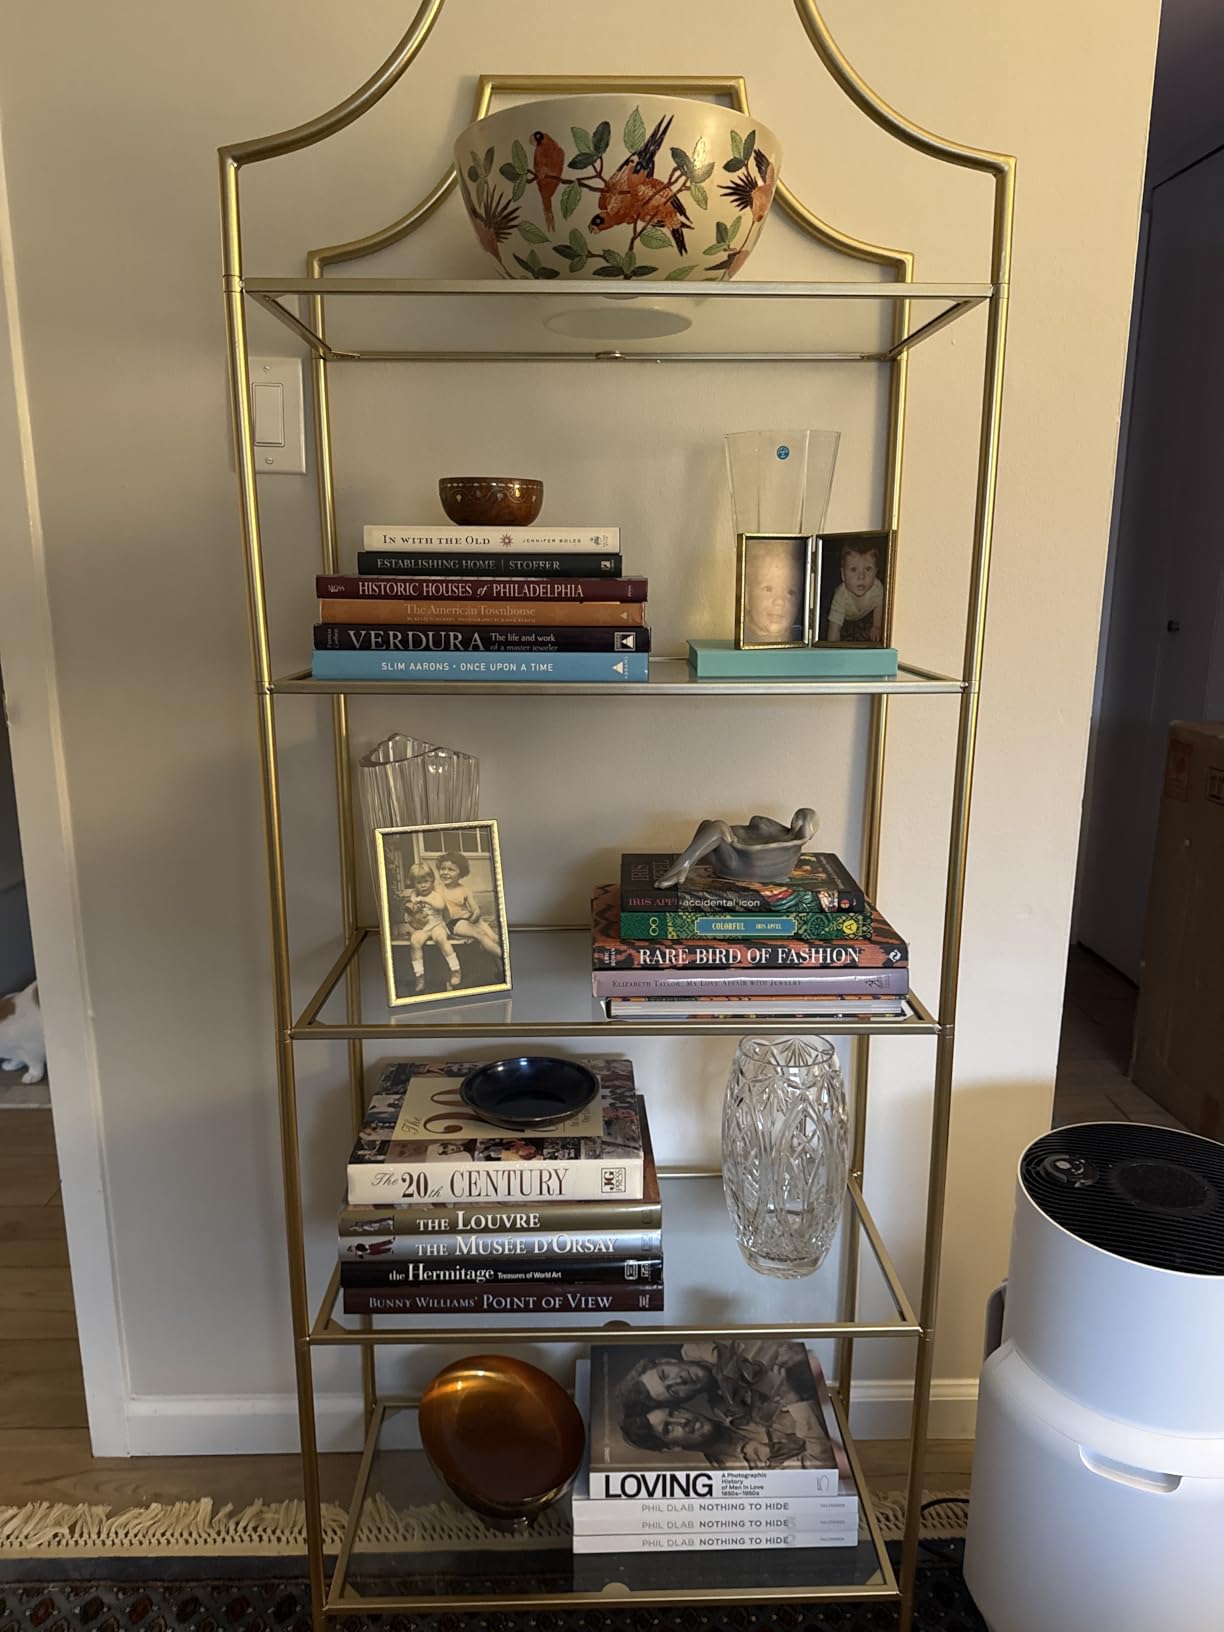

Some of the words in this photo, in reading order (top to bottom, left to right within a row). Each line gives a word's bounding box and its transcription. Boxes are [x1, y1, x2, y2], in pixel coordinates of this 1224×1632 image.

[383, 534, 396, 544] IN
[401, 536, 433, 545] WITH
[437, 536, 462, 545] THE
[465, 535, 490, 545] OLD
[377, 558, 459, 569] ESTABLISHING
[462, 560, 496, 569] HOME
[509, 560, 560, 570] STOFFER
[359, 581, 419, 595] HISTORIC
[423, 583, 473, 597] HOUSES
[477, 584, 489, 598] of
[493, 584, 584, 597] PHILADELPHIA
[404, 603, 427, 615] The
[428, 605, 477, 615] American
[479, 605, 536, 616] Townhouse
[348, 630, 485, 650] VERDURA
[490, 633, 506, 642] The
[508, 633, 520, 642] life
[521, 634, 536, 642] and
[537, 633, 556, 642] work
[381, 662, 405, 671] SLIM
[409, 663, 449, 671] AARONS
[460, 663, 486, 671] ONCE
[490, 663, 516, 671] UPON
[520, 663, 527, 671] A
[531, 663, 553, 671] TIME
[628, 898, 651, 906] IRIS
[682, 898, 736, 907] accidental
[738, 898, 760, 907] icon
[712, 922, 745, 931] COLORFUL
[639, 948, 689, 965] RARE
[696, 948, 741, 964] BIRD
[747, 948, 772, 964] OF
[777, 948, 860, 964] FASHION
[371, 1172, 399, 1186] The
[450, 1168, 568, 1198] CENTURY
[603, 1171, 614, 1190] JG
[615, 1170, 623, 1191] PRESS
[417, 1219, 450, 1231] THE
[456, 1211, 541, 1230] LOUVRE
[416, 1243, 449, 1256] THE
[455, 1236, 527, 1256] MUSÉE
[389, 1270, 405, 1281] the
[408, 1263, 494, 1283] Hermitage
[533, 1271, 551, 1279] World
[369, 1297, 411, 1308] BUNNY
[483, 1294, 536, 1309] POINT
[542, 1297, 563, 1309] OF
[568, 1293, 613, 1308] VIEW
[605, 1473, 713, 1498] LOVING
[641, 1504, 664, 1513] PHIL
[667, 1504, 695, 1512] DLAB
[699, 1503, 746, 1511] NOTHING
[641, 1521, 664, 1529] PHIL
[641, 1539, 664, 1548] PHIL
[667, 1539, 695, 1547] DLAB
[699, 1537, 746, 1546] NOTHING
[749, 1537, 762, 1545] TO
[765, 1536, 789, 1545] HIDE
